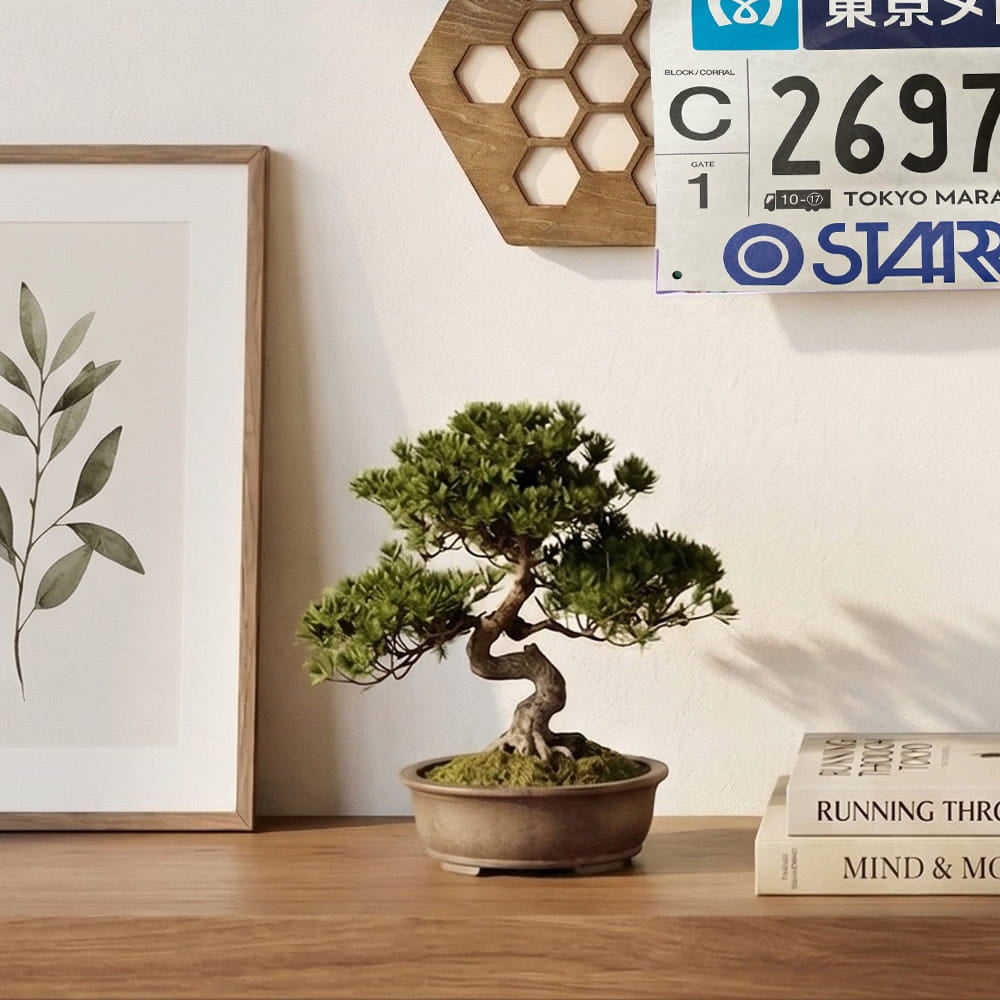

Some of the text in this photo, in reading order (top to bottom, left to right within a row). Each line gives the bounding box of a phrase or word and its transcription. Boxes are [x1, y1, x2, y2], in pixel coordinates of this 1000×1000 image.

[669, 85, 732, 142] C
[690, 161, 716, 169] GATE
[687, 172, 709, 209] 1
[843, 190, 928, 207] TOKYO
[817, 800, 935, 822] RUNNING
[843, 855, 924, 880] MIND
[932, 855, 953, 880] &
